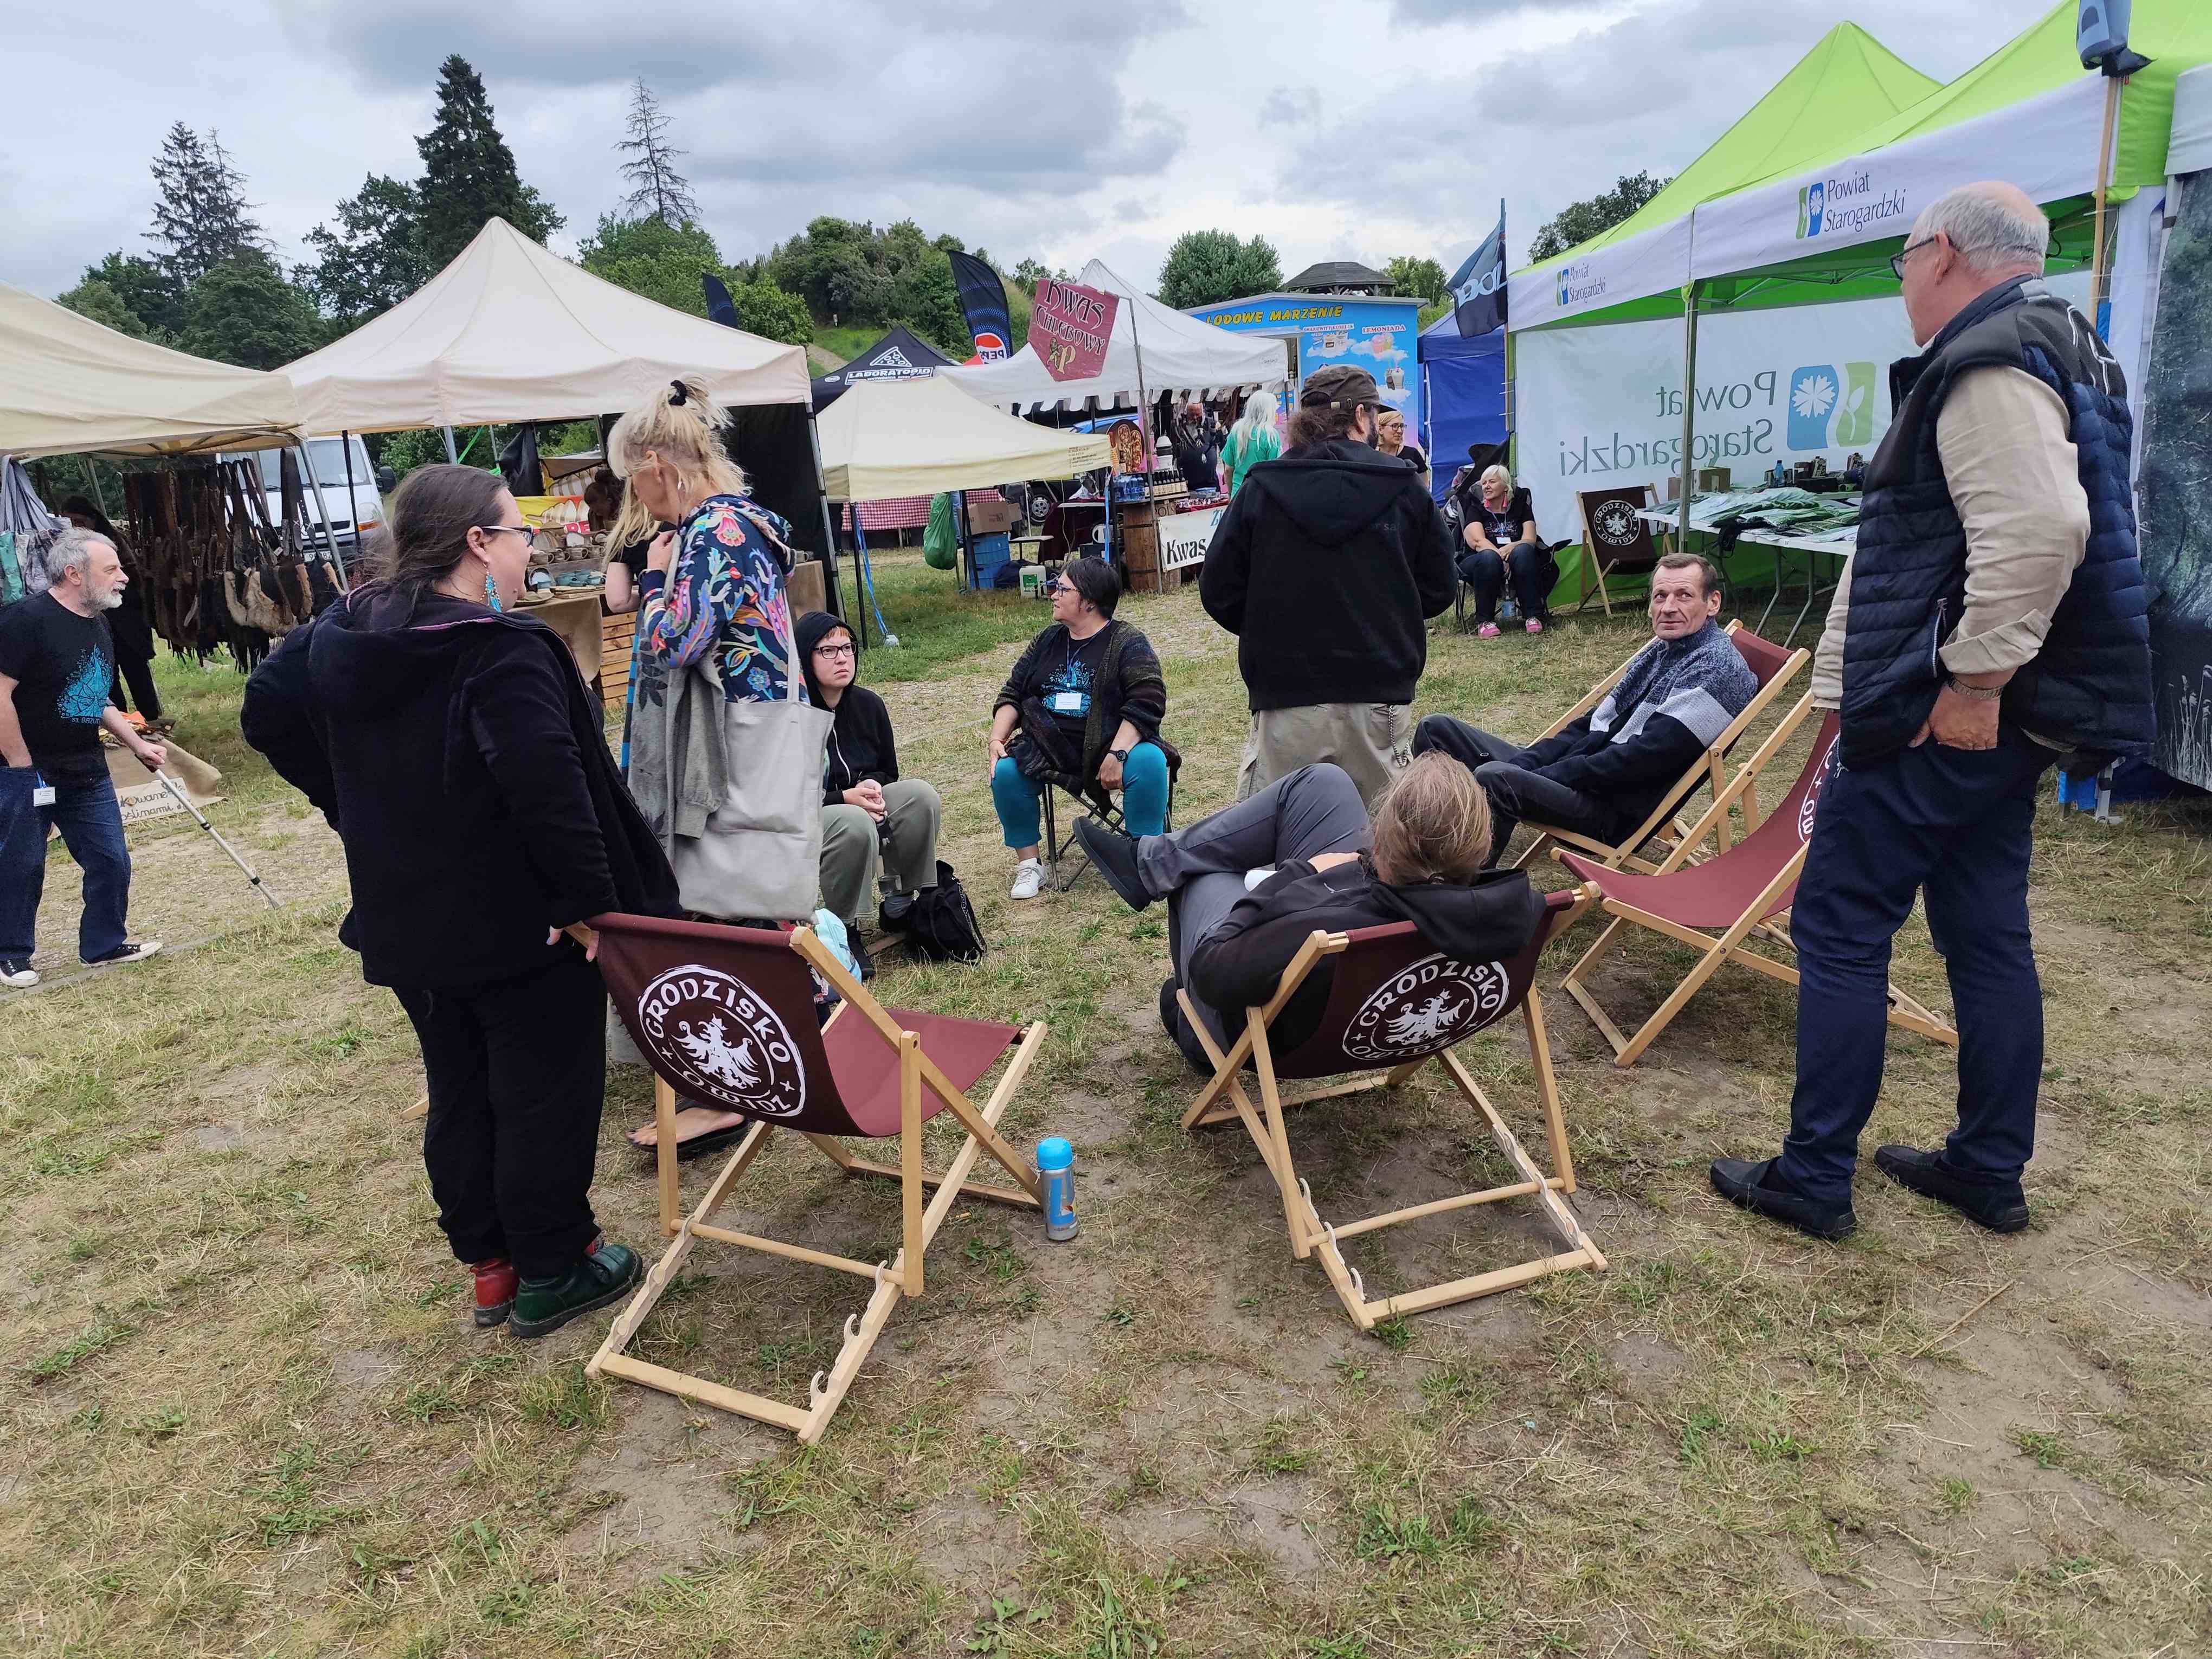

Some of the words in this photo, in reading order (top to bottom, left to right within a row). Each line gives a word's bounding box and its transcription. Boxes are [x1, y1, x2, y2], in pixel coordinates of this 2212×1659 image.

[1828, 171, 1870, 202] Powiat
[1824, 189, 1906, 232] Starogardzki
[1570, 262, 1589, 282] Powiat
[1044, 280, 1105, 330] KWAS
[1569, 276, 1606, 304] Starogardzki
[1036, 304, 1105, 355] CHLEBOWY
[1206, 311, 1263, 326] LODOWE
[1269, 305, 1343, 322] MARZENIE
[1362, 325, 1405, 333] LEMONIADA
[1167, 538, 1206, 564] Kwas
[1359, 960, 1500, 1027] GRODZISKO
[646, 978, 790, 1063] GRODZISKO
